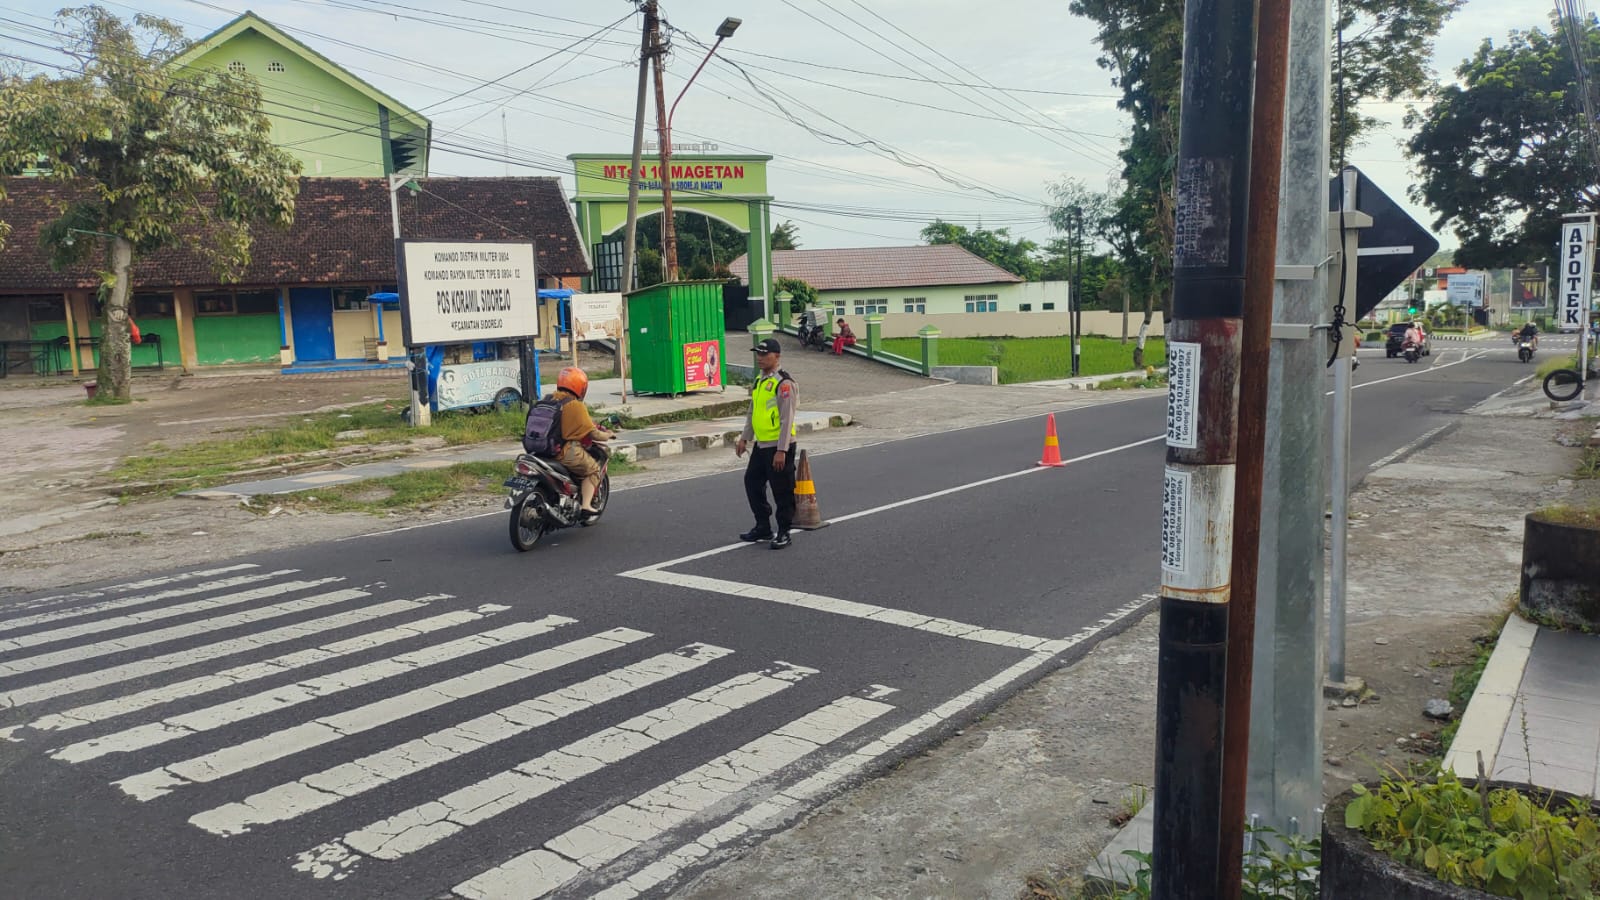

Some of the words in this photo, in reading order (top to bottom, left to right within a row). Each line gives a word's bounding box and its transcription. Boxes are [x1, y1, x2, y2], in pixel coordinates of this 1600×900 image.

[671, 165, 744, 179] MAGETAN
[1176, 205, 1185, 256] SEDOT
[434, 251, 459, 262] KOMANDO
[460, 251, 479, 262] DISTRIK
[480, 251, 497, 262] MILITER
[424, 270, 449, 280] KOMANDO
[450, 270, 466, 280] RAYON
[467, 269, 486, 280] MILITER
[486, 269, 496, 279] TIPE
[1565, 228, 1583, 324] APOTEK
[437, 290, 451, 314] POS
[451, 289, 481, 313] KORAMIL
[481, 288, 511, 313] SIDOREJO
[480, 318, 503, 330] SIDOREJO
[1170, 350, 1177, 378] WC
[1168, 381, 1176, 439] SEDOT
[1175, 426, 1181, 440] WA
[1164, 477, 1170, 503] WC
[1168, 551, 1174, 565] WA
